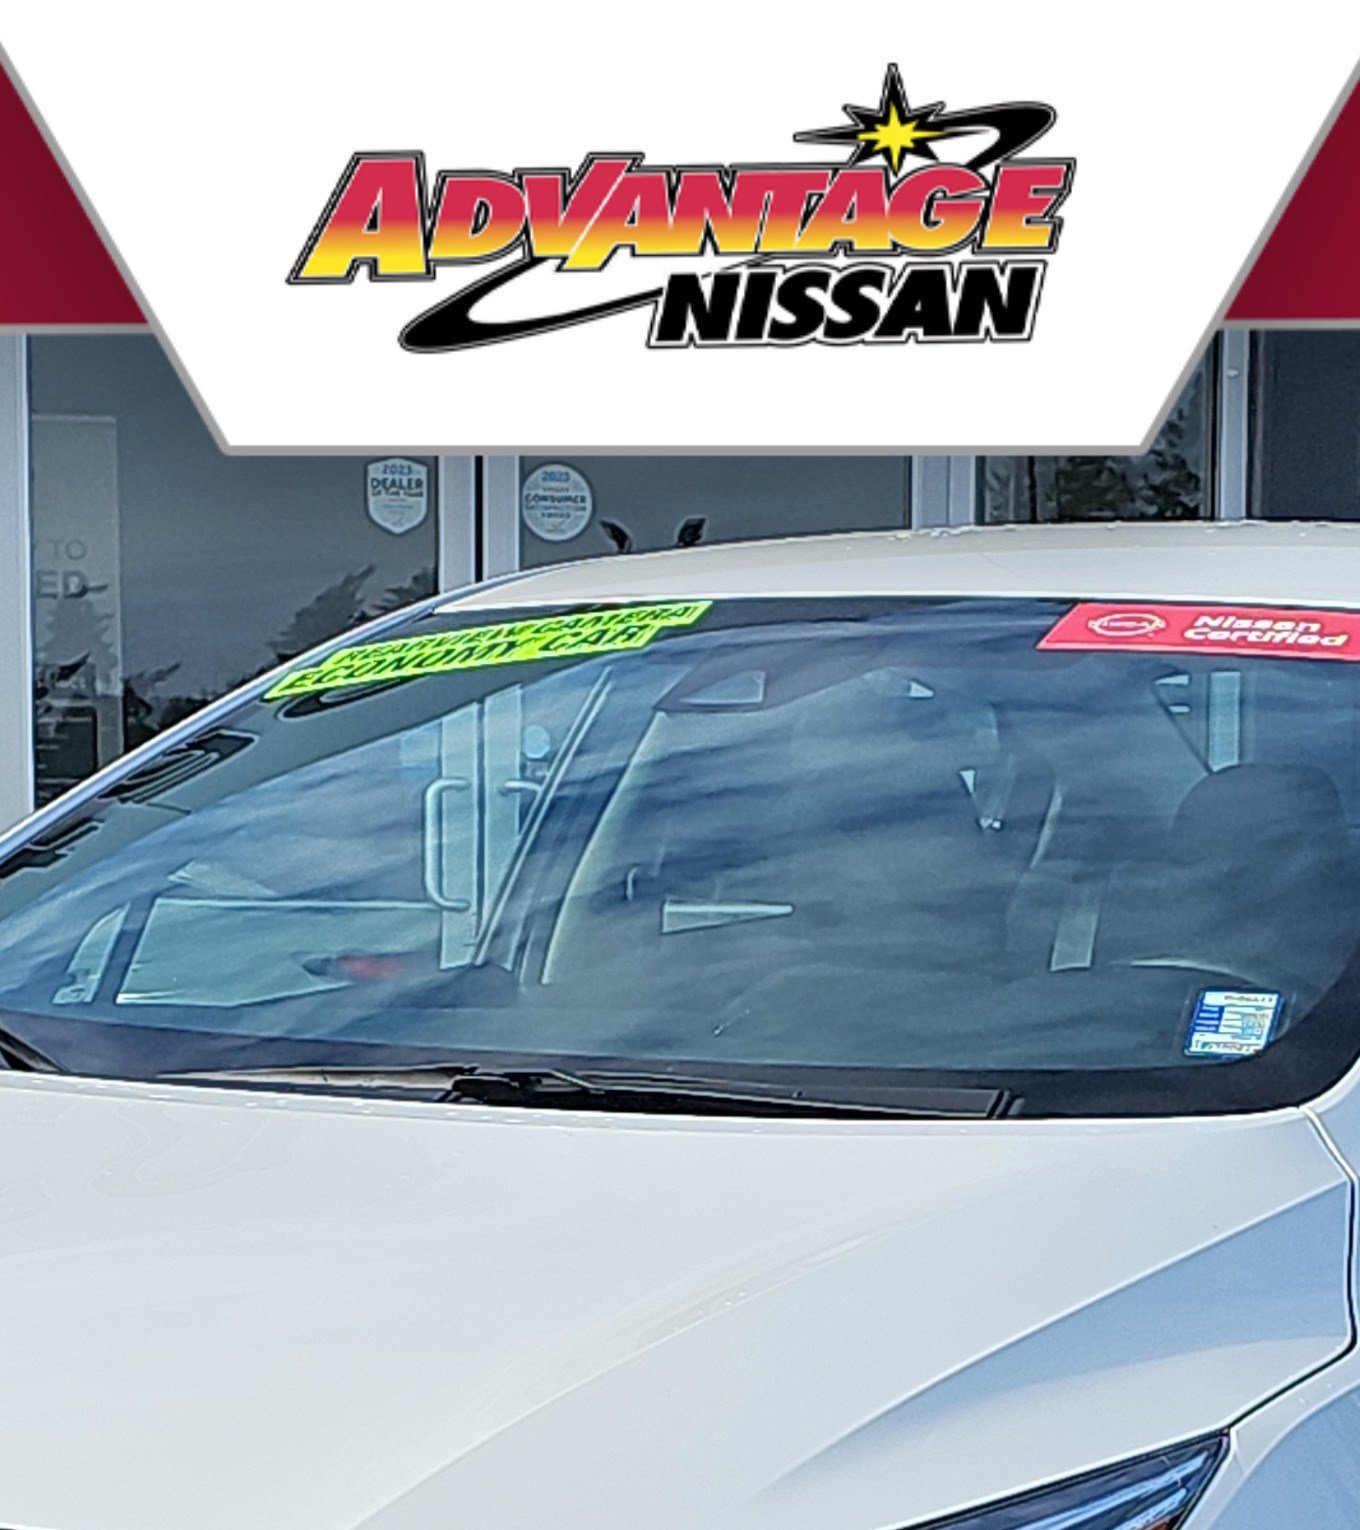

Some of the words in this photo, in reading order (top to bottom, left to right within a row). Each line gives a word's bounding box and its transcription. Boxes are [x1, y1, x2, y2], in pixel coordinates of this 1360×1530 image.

[371, 478, 424, 489] DEALER
[1194, 615, 1320, 632] Nissan
[1184, 629, 1348, 646] Certified
[283, 640, 519, 690] ECONOMY
[541, 625, 647, 652] CAR
